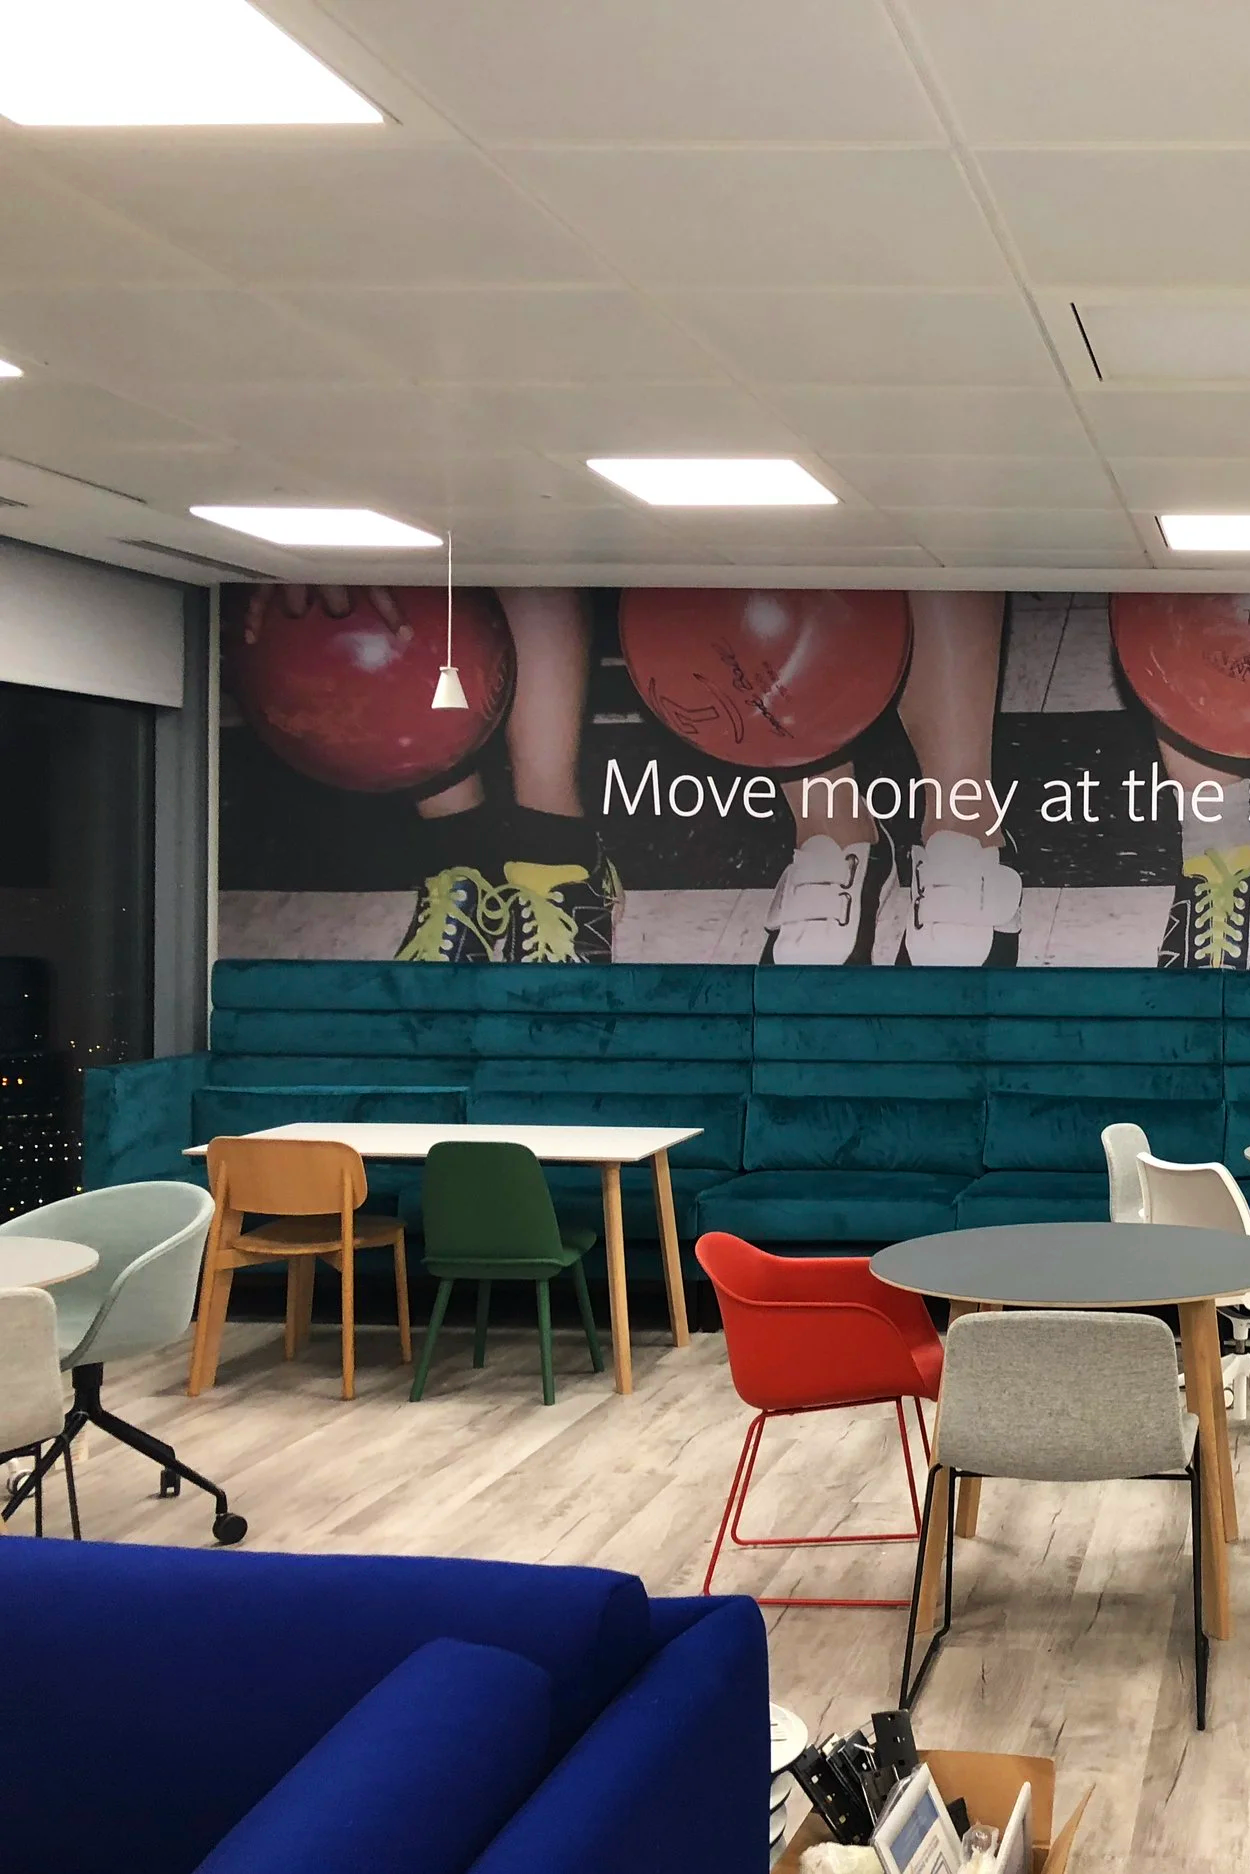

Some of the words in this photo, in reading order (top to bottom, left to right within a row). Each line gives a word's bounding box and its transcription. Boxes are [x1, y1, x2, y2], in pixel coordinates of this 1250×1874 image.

[603, 760, 776, 819] Move
[802, 777, 1019, 837] money
[1041, 770, 1100, 822] at
[1122, 762, 1224, 823] the
